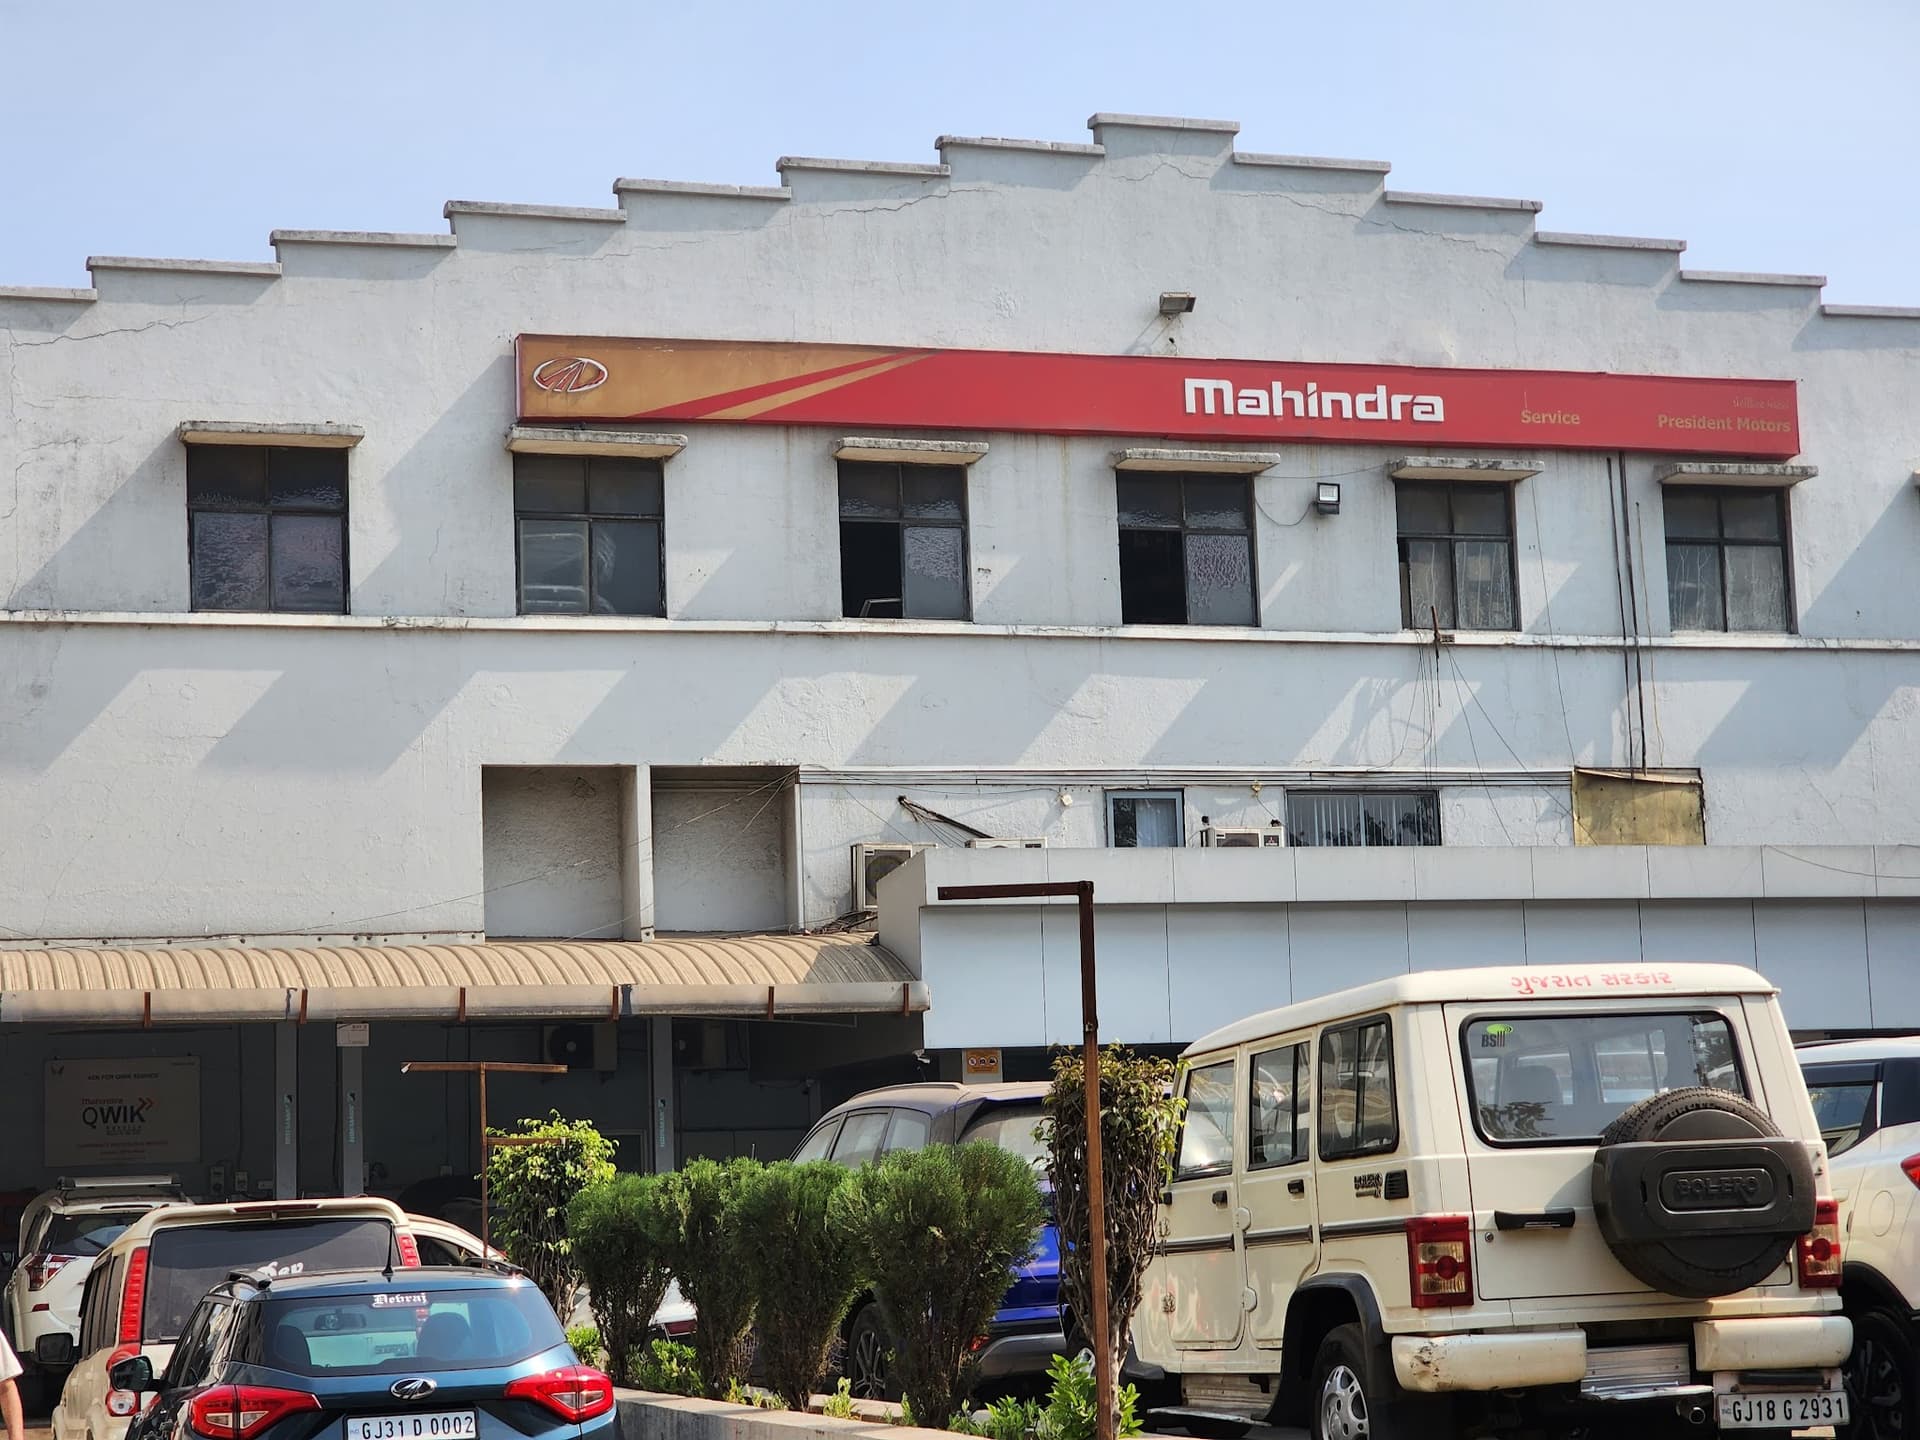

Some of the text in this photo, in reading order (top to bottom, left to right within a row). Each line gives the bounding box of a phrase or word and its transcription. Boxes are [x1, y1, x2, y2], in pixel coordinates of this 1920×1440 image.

[1521, 410, 1581, 425] Service
[1657, 414, 1792, 432] President Motors
[1511, 972, 1672, 994] ગુજરાત સરકાર
[82, 1105, 145, 1129] QWIK
[1676, 1176, 1759, 1199] BOLERO
[1733, 1397, 1843, 1422] GJ18 G 2931
[362, 1416, 473, 1439] GJ31 D 0002
